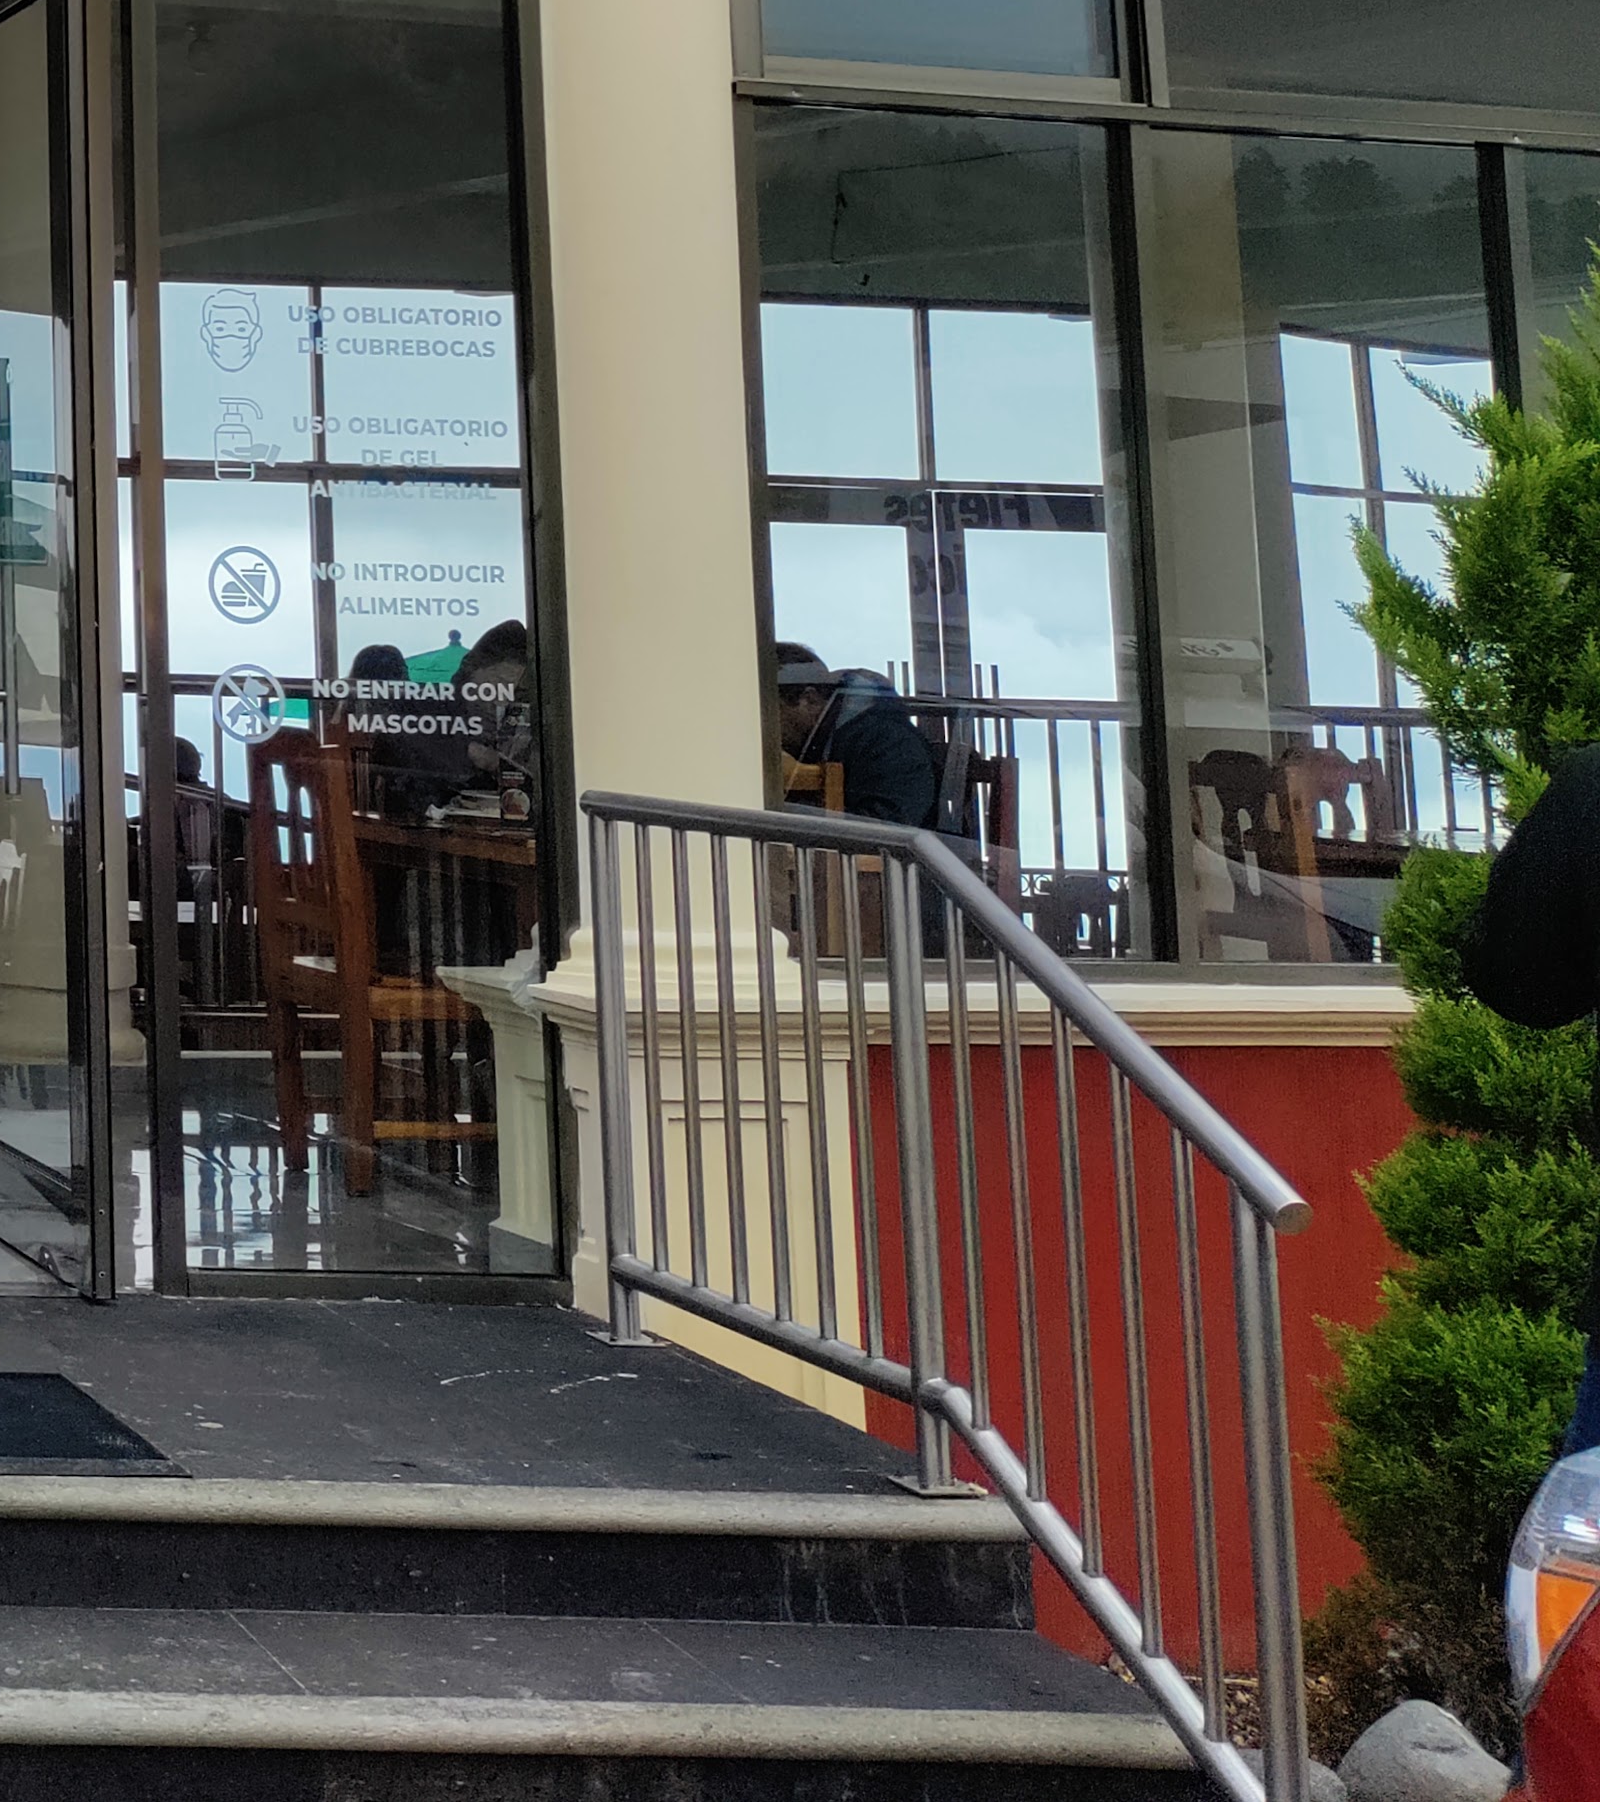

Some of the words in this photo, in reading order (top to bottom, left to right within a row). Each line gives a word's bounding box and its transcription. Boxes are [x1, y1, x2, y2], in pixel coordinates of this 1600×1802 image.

[288, 305, 335, 323] USO
[343, 306, 502, 327] OBLIGATORIO
[298, 337, 329, 354] DE
[336, 337, 496, 358] CUBREBOCAS
[292, 416, 341, 434] USO
[348, 417, 508, 438] OBLIGATORIO
[361, 449, 393, 466] DE
[400, 450, 444, 467] GEL
[310, 479, 497, 500] ANTIBACTERIAL
[311, 562, 346, 581] NO
[354, 563, 505, 583] INTRODUCIR
[339, 597, 480, 617] ALIMENTOS
[312, 679, 349, 699] NO
[357, 680, 455, 701] ENTRAR
[461, 682, 515, 702] CON
[347, 713, 483, 735] MASCOTAS
